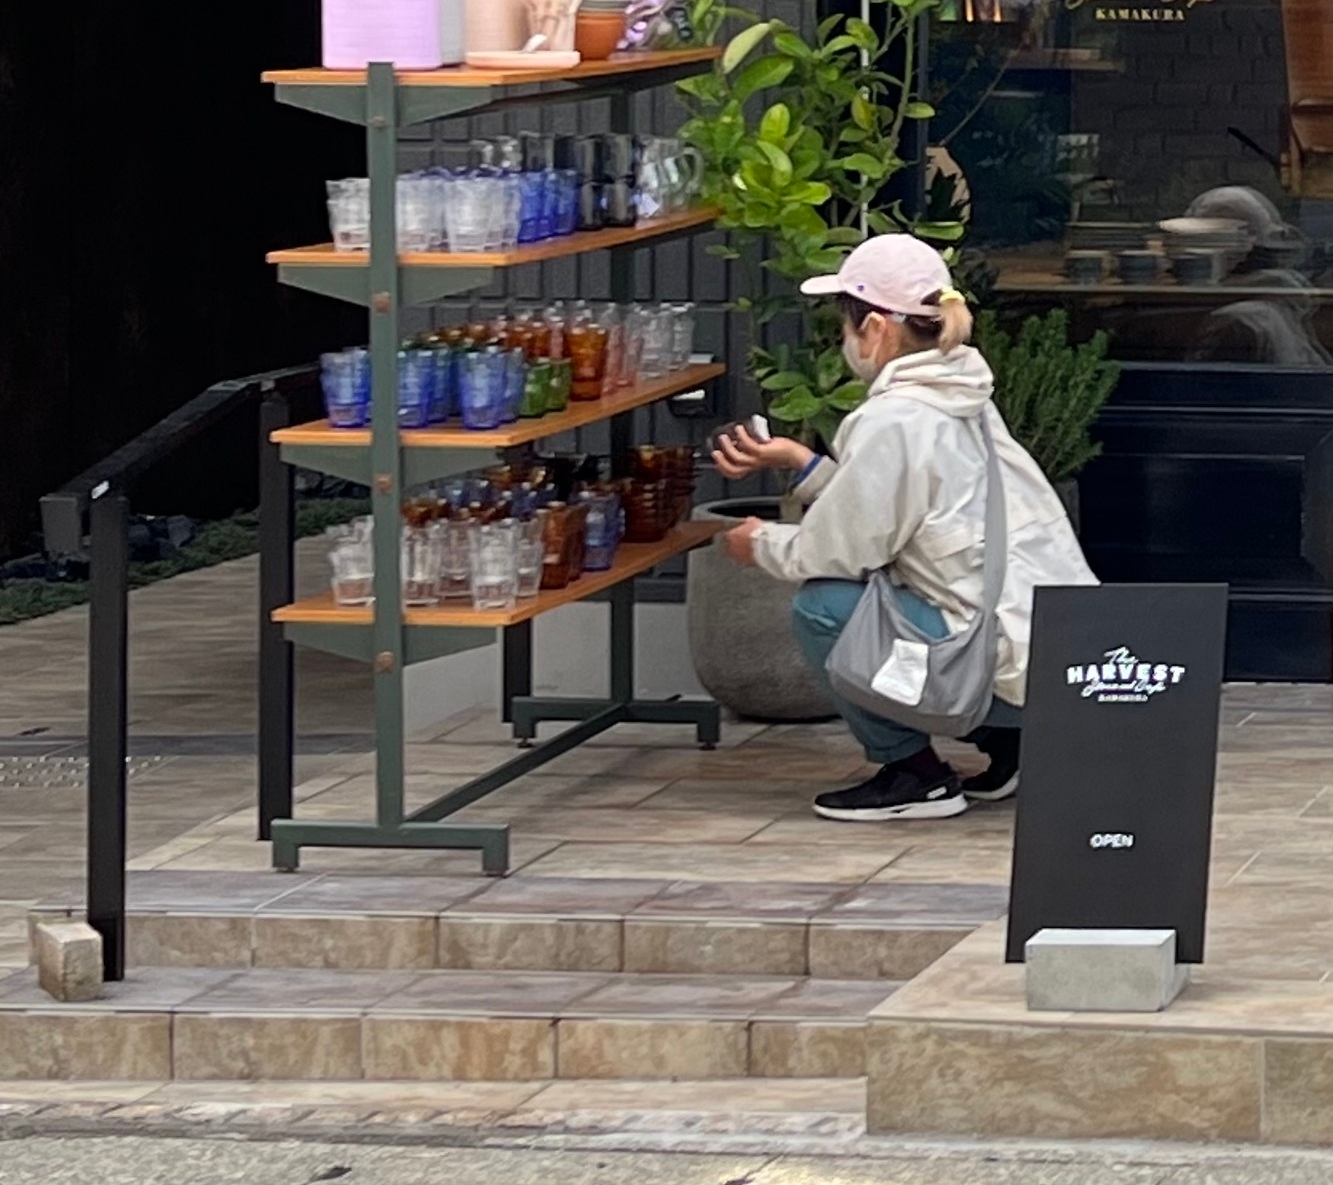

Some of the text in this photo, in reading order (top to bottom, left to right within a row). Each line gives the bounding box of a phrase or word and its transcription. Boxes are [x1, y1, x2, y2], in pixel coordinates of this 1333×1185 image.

[1095, 8, 1185, 21] KAMAKURA
[1066, 662, 1186, 685] HARVEST
[1089, 833, 1134, 848] OPEN
